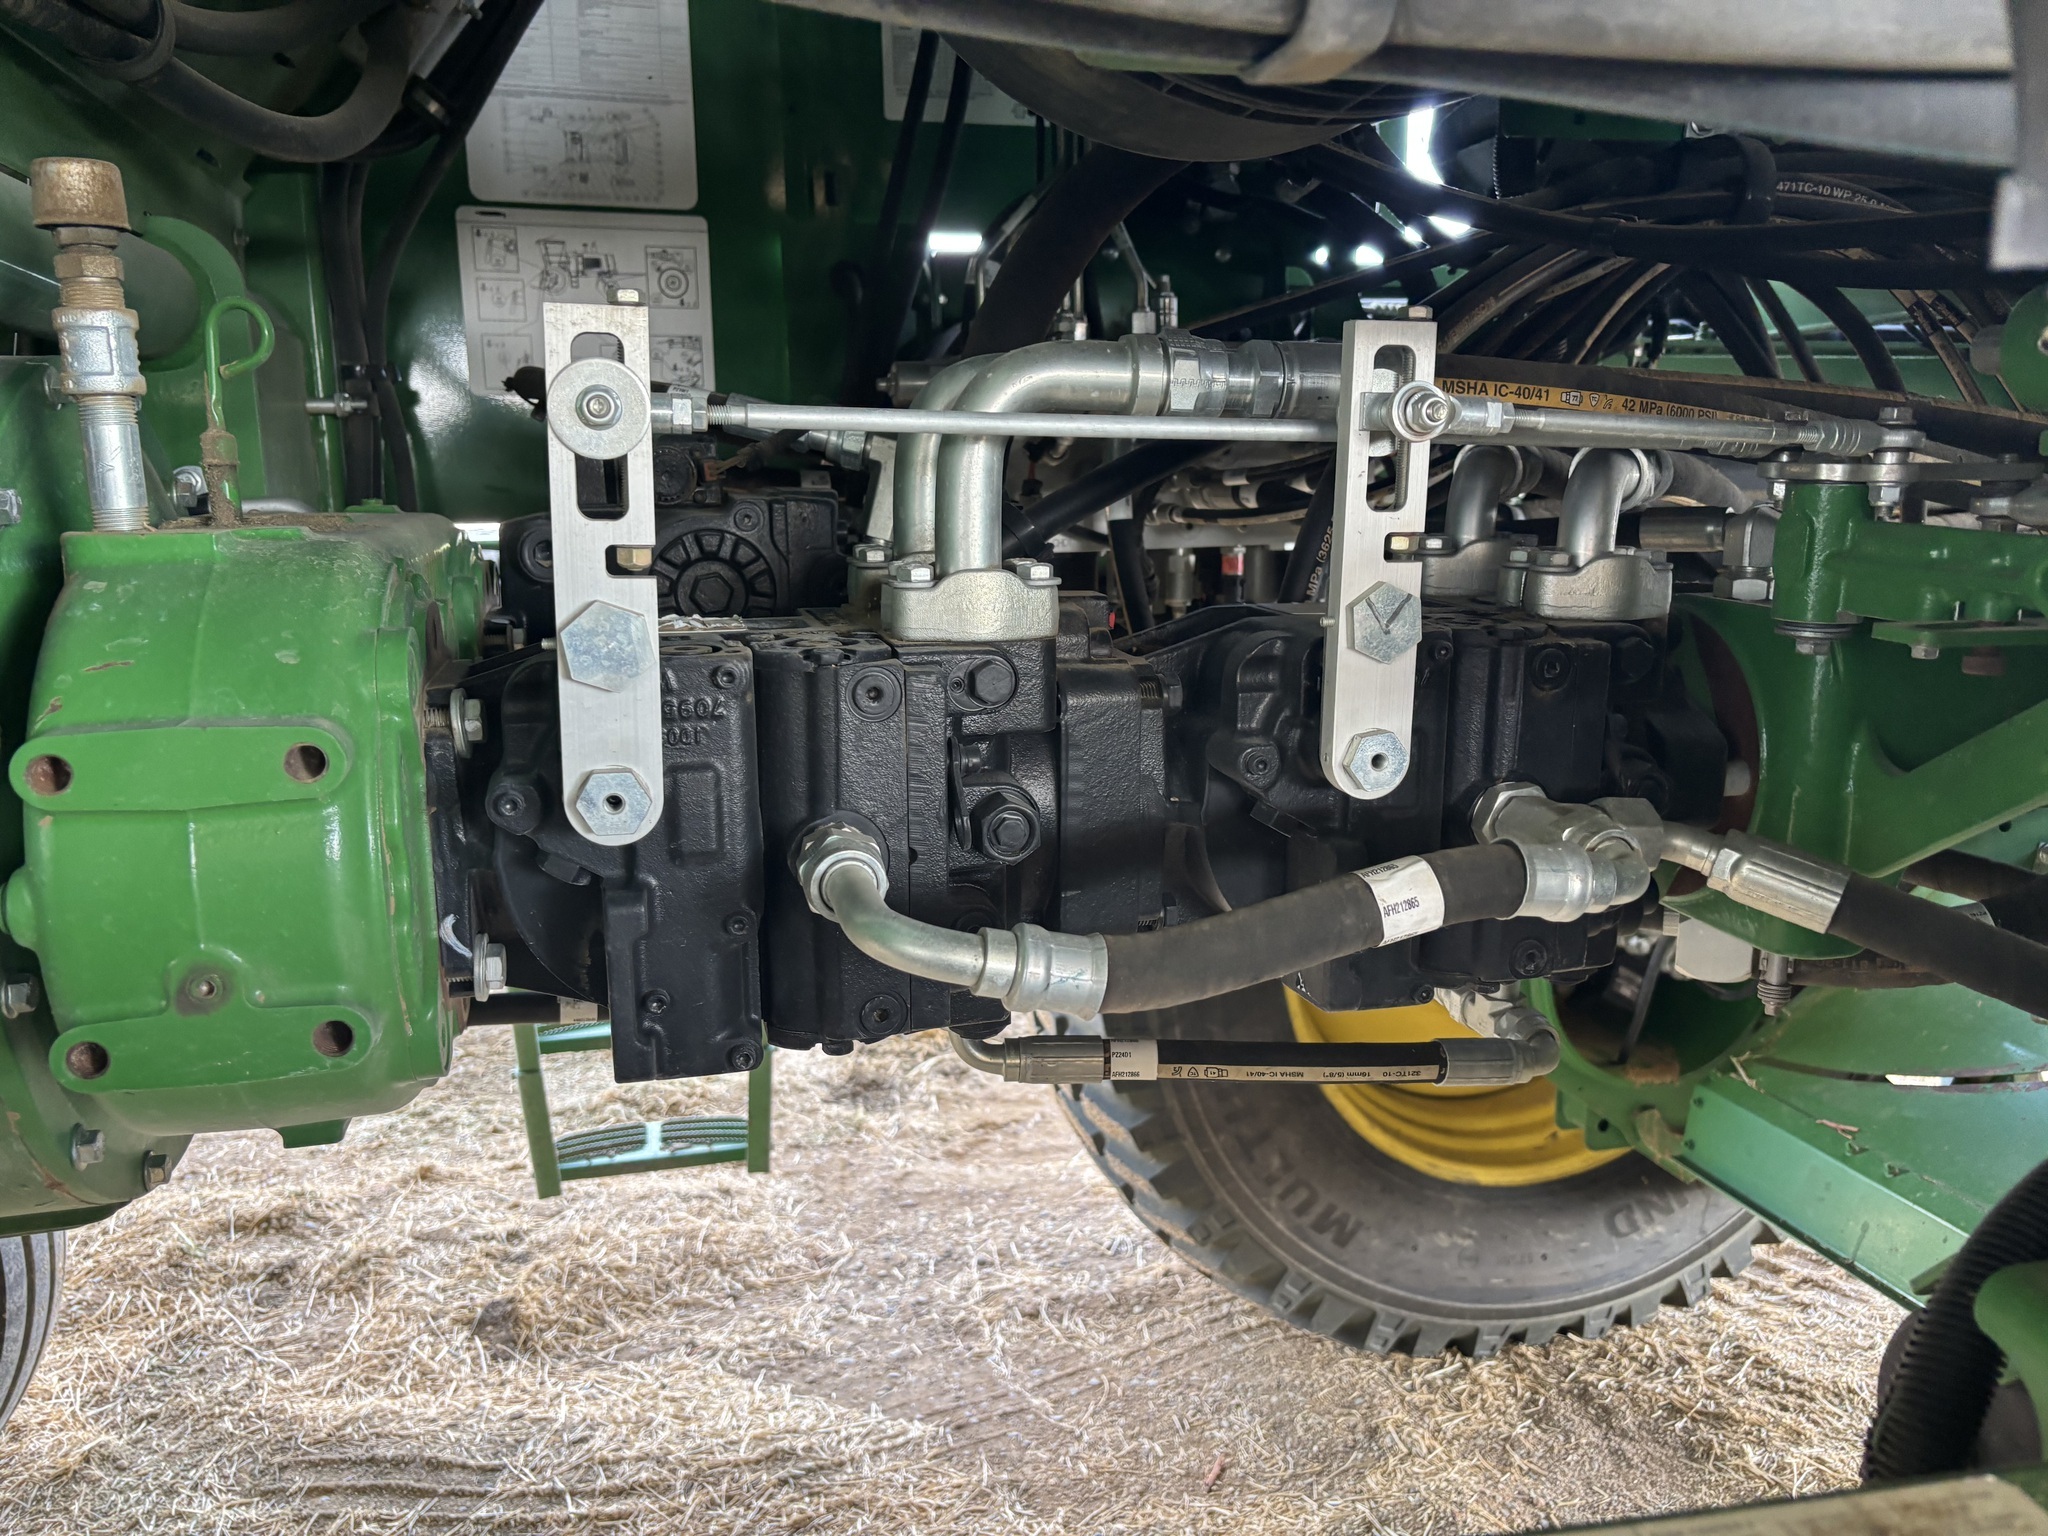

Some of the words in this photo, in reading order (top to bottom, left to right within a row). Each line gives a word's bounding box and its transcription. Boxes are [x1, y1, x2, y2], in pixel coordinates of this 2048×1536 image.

[1776, 181, 1831, 196] 471TC-10
[1833, 187, 1852, 199] WP
[1442, 380, 1488, 395] MSHA
[1494, 383, 1550, 401] IC-40/41
[1621, 398, 1636, 412] 42
[1639, 400, 1663, 415] MPa
[1666, 404, 1695, 418] (6000
[1306, 566, 1322, 597] MPa
[1383, 897, 1420, 918] AFH212865
